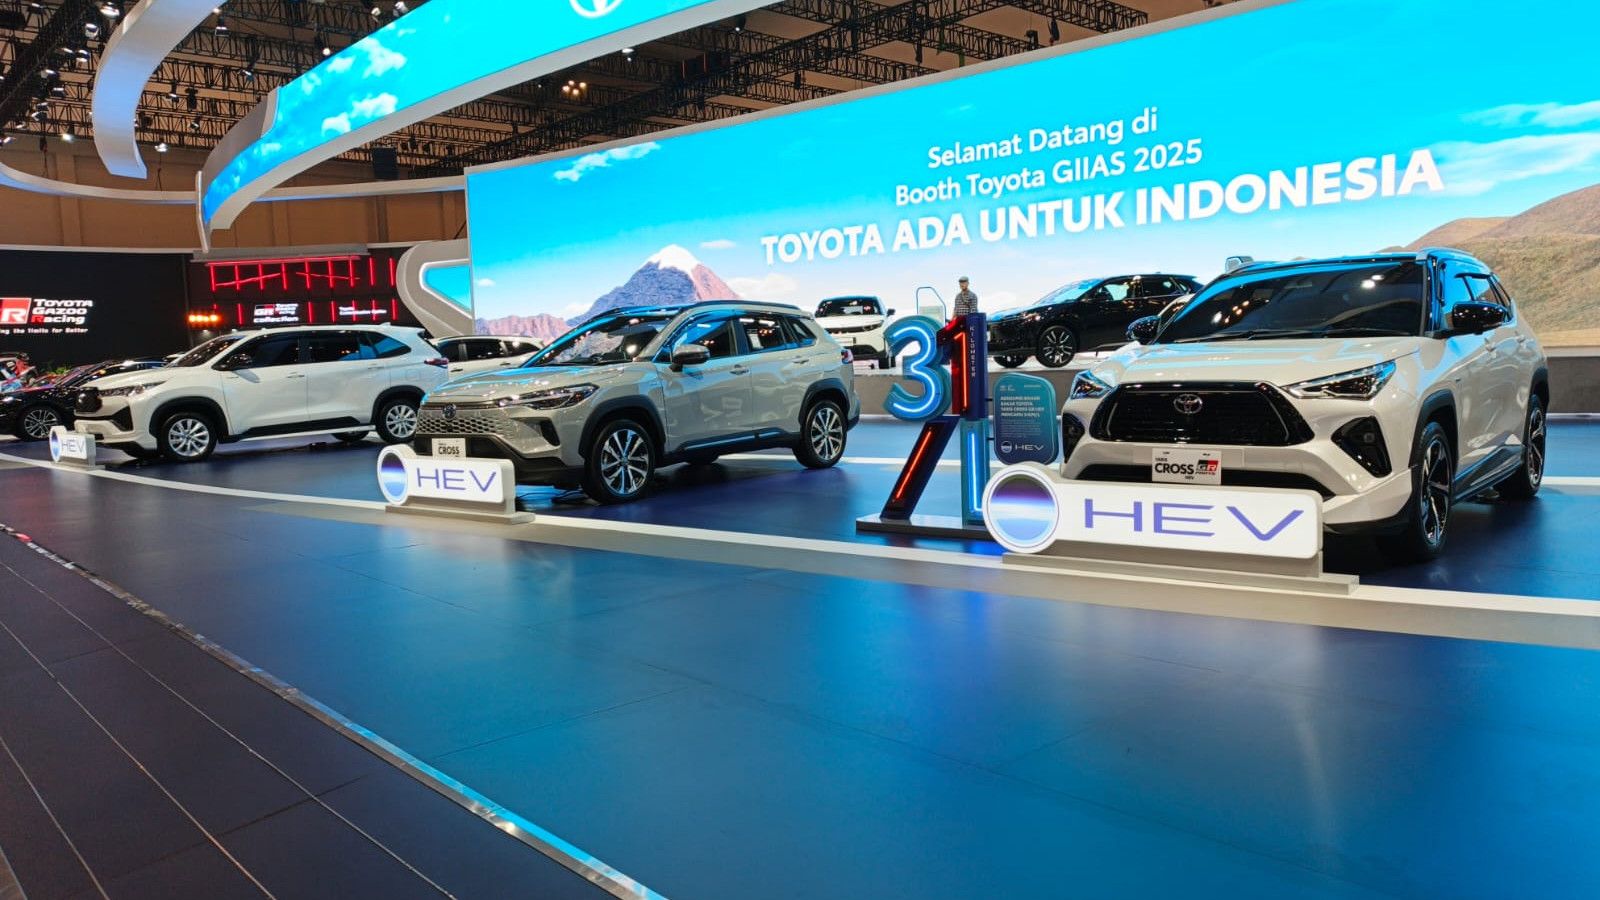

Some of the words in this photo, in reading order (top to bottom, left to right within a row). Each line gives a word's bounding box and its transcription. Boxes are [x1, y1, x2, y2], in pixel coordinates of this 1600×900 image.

[928, 133, 1022, 168] Selamat
[1029, 119, 1124, 152] Datang
[1132, 107, 1158, 134] di
[896, 180, 961, 206] Booth
[967, 169, 1045, 198] Toyota
[1053, 151, 1125, 183] GIIAS
[1133, 138, 1203, 173] 2025
[761, 223, 885, 265] TOYOTA
[893, 213, 970, 251] ADA
[979, 191, 1125, 242] UNTUK
[1136, 149, 1445, 226] INDONESIA
[31, 314, 85, 324] Racing
[62, 438, 85, 453] HEV
[438, 446, 460, 455] CROSS
[416, 467, 497, 492] HEV
[1155, 462, 1194, 475] CROSS
[1084, 498, 1305, 541] HEV
